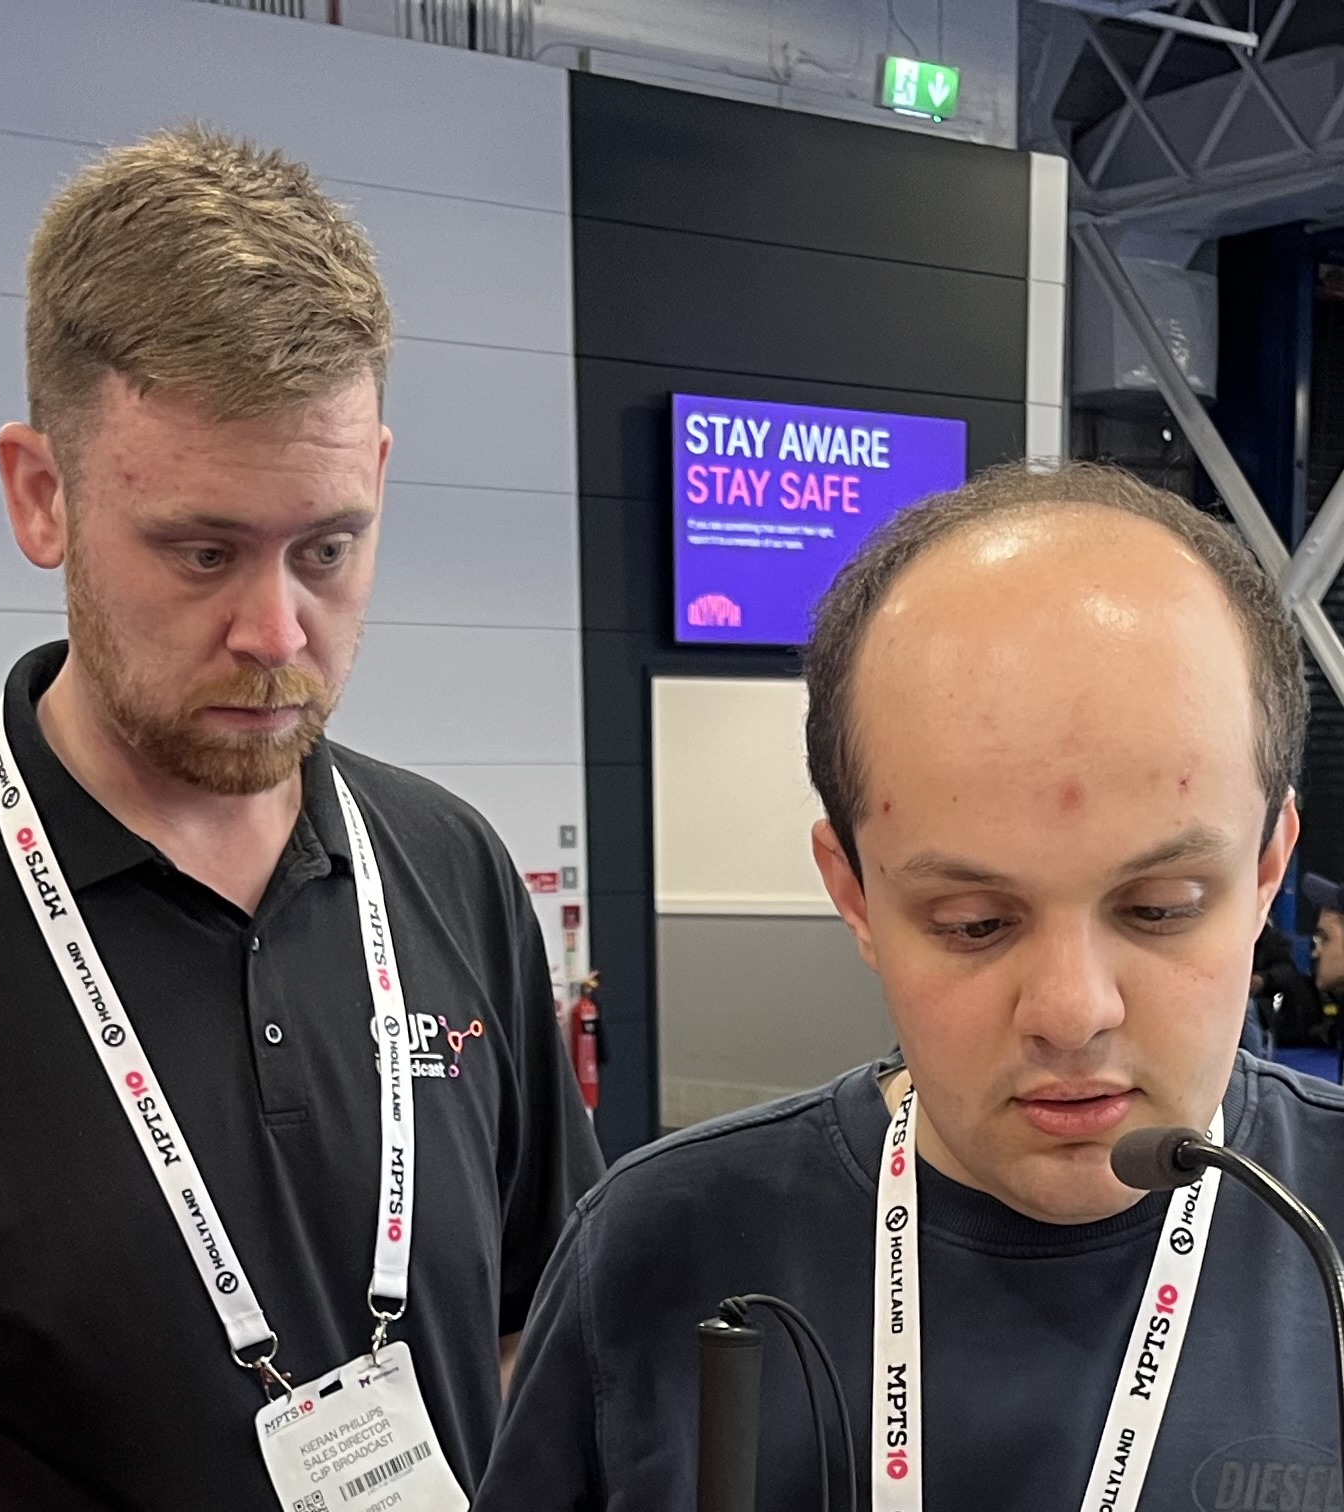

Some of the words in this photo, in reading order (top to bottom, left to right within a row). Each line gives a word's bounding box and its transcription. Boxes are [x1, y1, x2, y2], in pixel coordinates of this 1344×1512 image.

[685, 413, 771, 459] STAY
[778, 421, 891, 469] AWARE
[686, 464, 771, 508] STAY
[779, 472, 862, 514] SAFE
[16, 827, 67, 921] MPTS10
[66, 941, 112, 1023] HOLLYLAND
[368, 900, 391, 991] MPTS10
[124, 1071, 181, 1167] MPTS10
[389, 1040, 402, 1122] HOLLYLAND
[181, 1188, 226, 1271] HOLLYLAND
[387, 1146, 405, 1243] MPTS10
[889, 1236, 904, 1335] HOLLYLAND
[1129, 1284, 1179, 1400] MPTS10
[264, 1400, 314, 1434] MPTS10
[300, 1430, 339, 1456] KIERAN
[339, 1406, 384, 1436] PHILLIPS
[303, 1445, 339, 1471] SALES
[340, 1419, 391, 1450] DIRECTOR
[310, 1463, 332, 1483] CJP
[333, 1432, 395, 1474] BROADCAST
[886, 1363, 909, 1480] MPTS10
